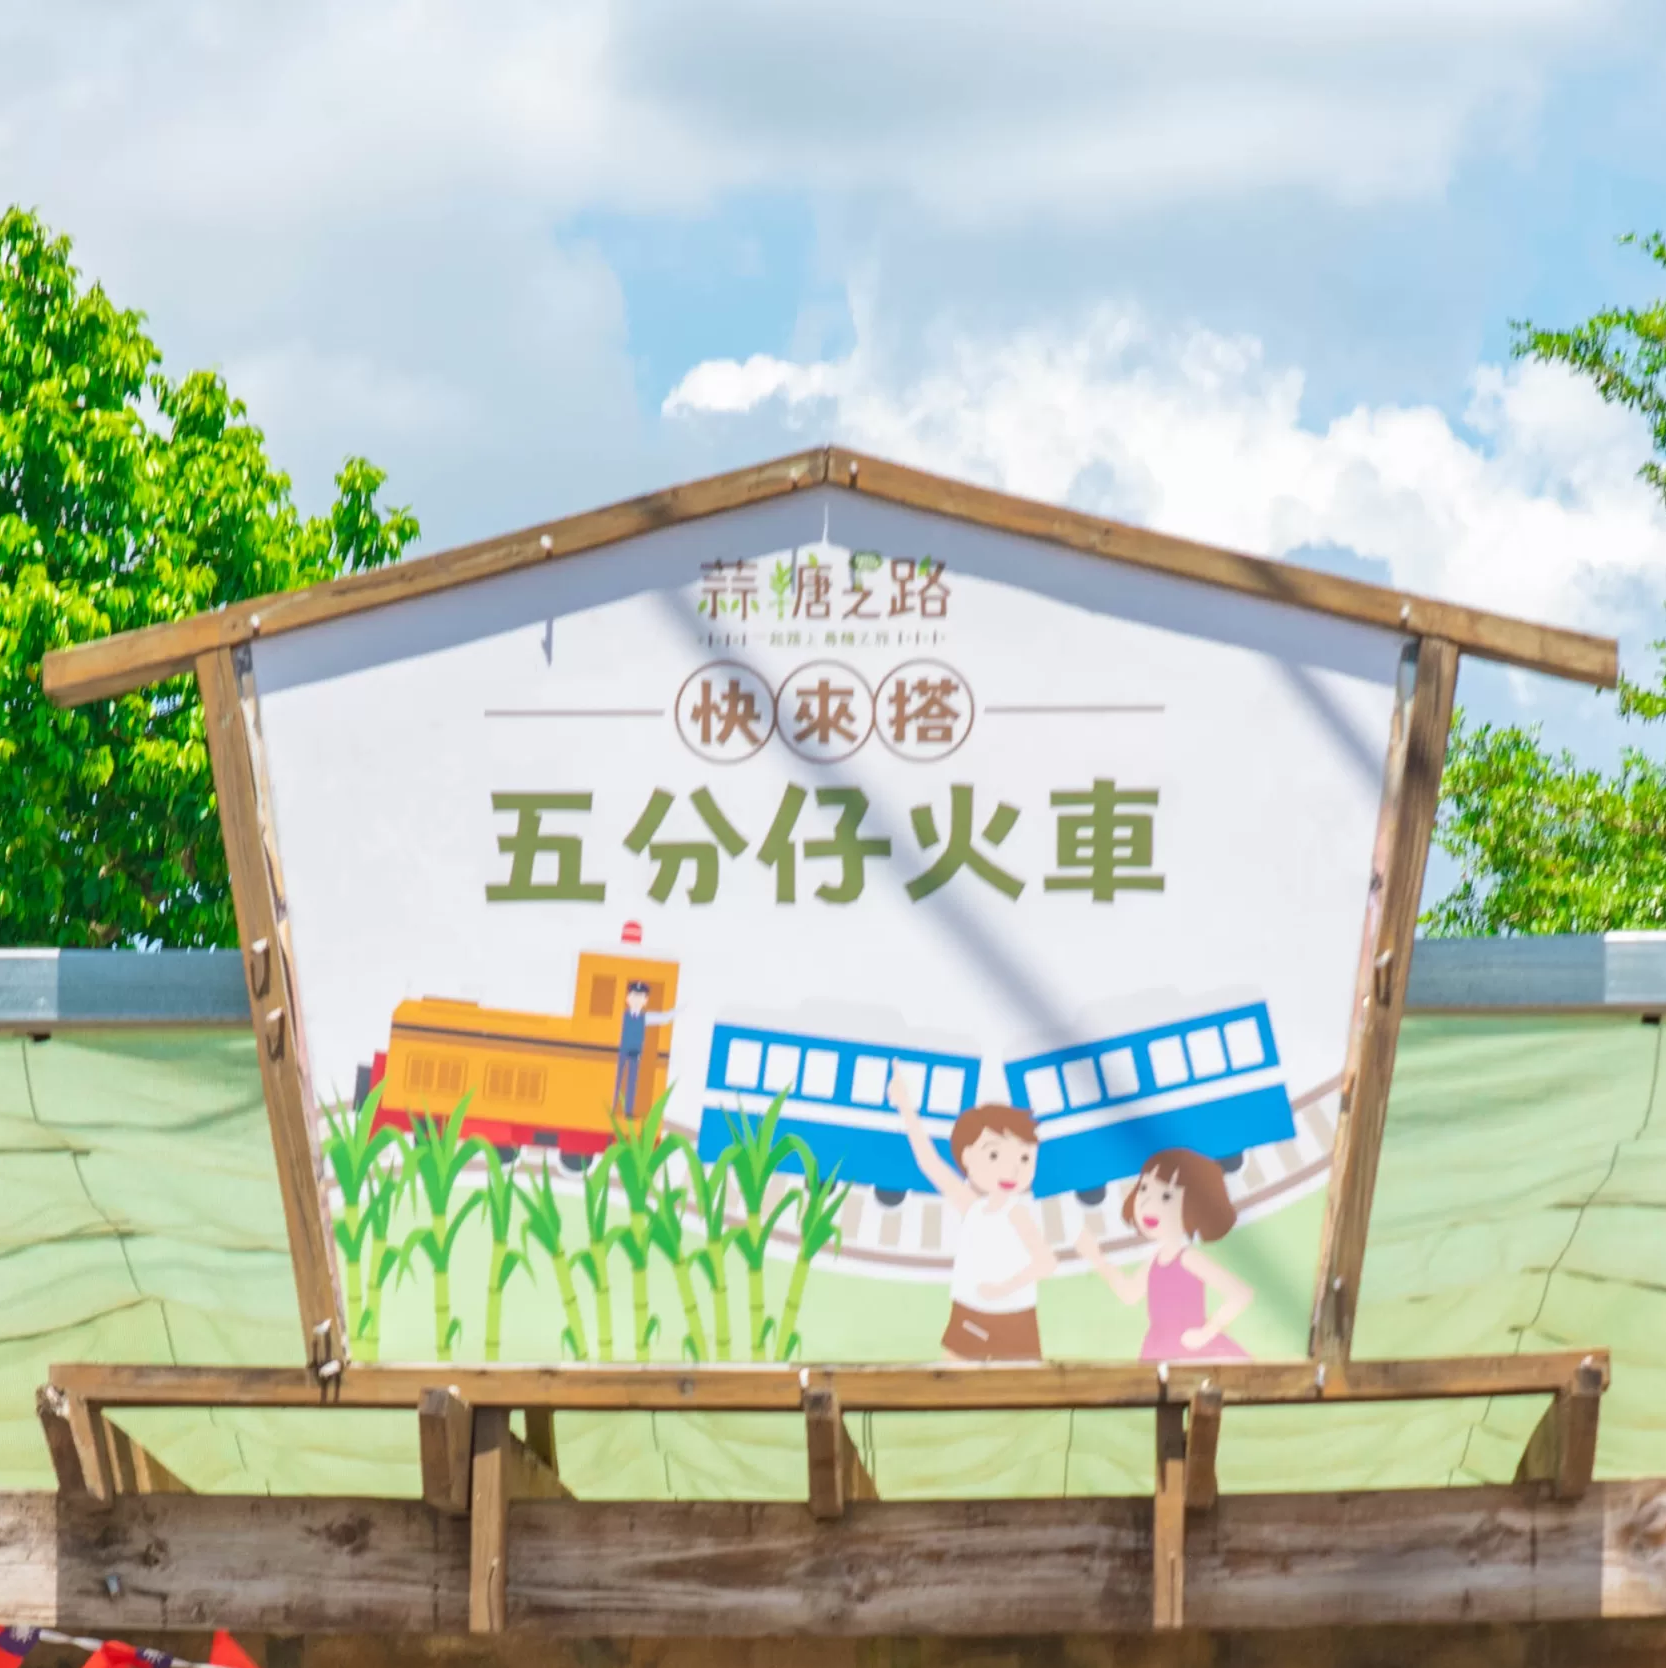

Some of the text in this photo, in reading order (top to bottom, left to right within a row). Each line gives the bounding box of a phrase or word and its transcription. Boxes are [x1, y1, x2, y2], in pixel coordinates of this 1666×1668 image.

[690, 677, 961, 746] 快來搭
[484, 778, 1166, 905] 五分仔火車
